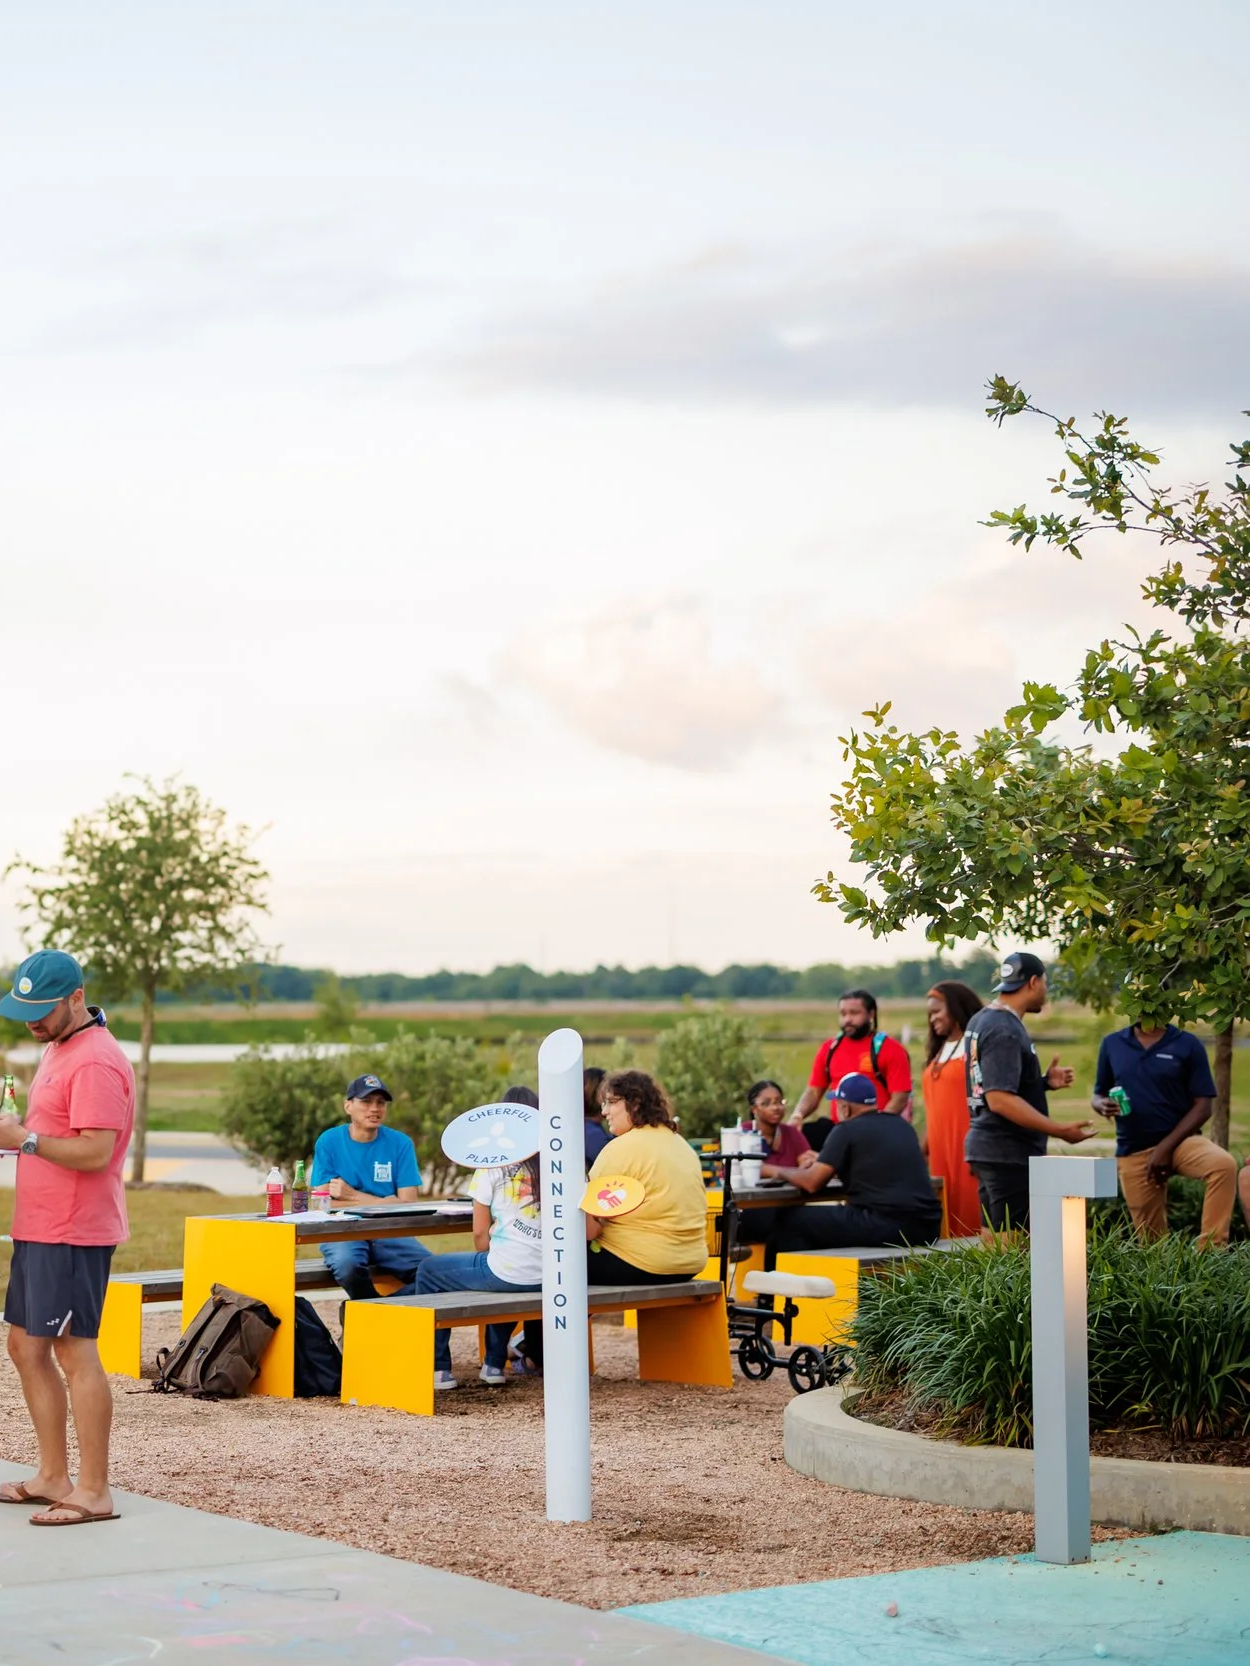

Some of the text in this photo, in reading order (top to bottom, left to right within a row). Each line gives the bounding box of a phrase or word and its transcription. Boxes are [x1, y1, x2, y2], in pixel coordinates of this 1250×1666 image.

[467, 1107, 533, 1123] CHEERFUL
[465, 1153, 509, 1164] PLAZA
[549, 1115, 568, 1330] CONNECTION
